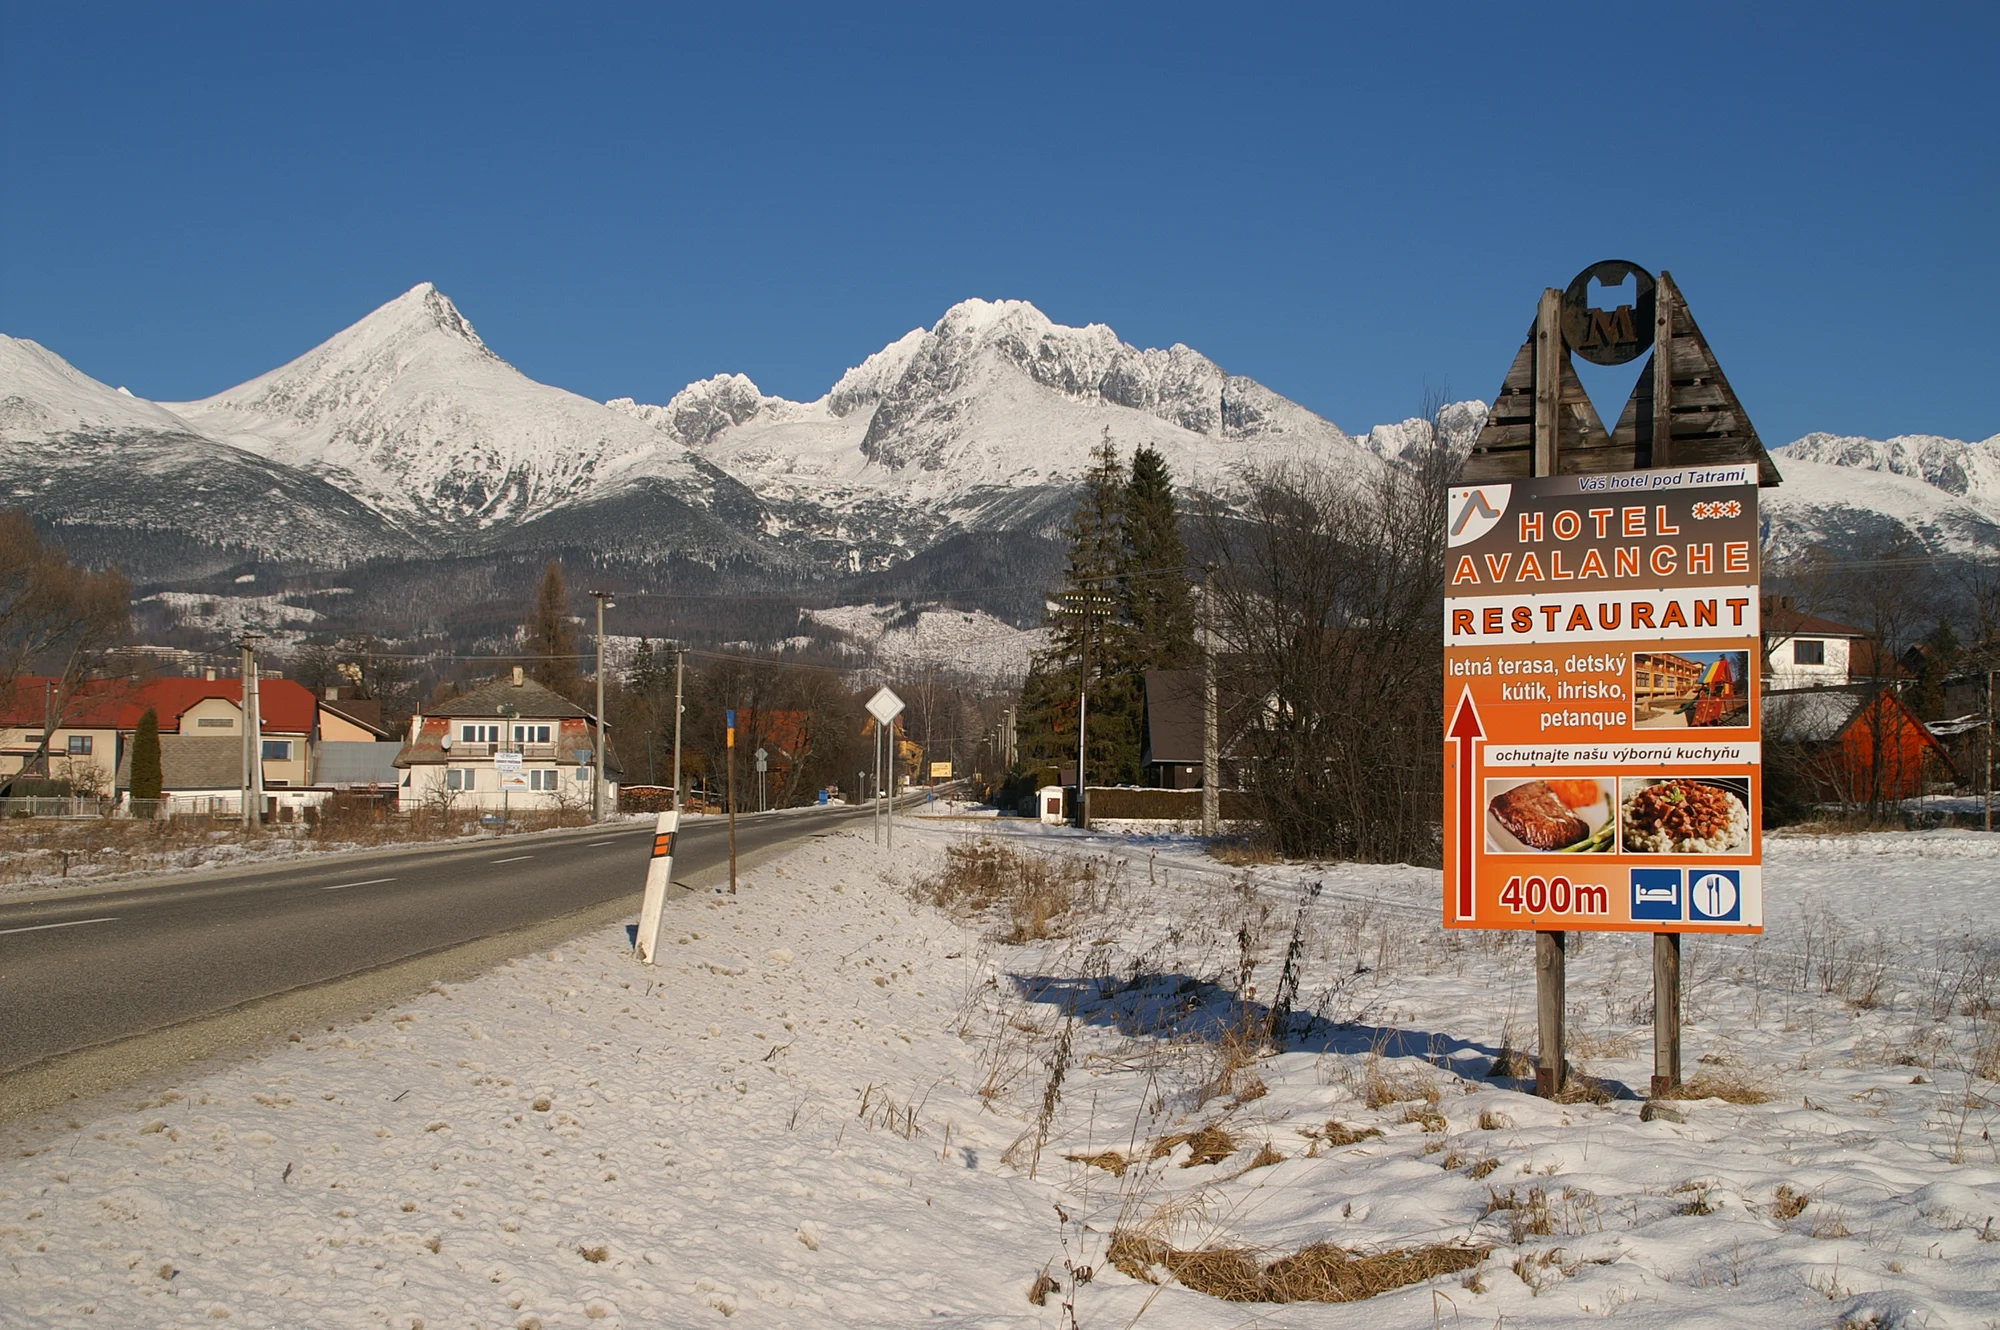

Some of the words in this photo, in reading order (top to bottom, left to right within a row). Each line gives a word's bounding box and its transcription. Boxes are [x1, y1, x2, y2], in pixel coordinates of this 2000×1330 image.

[1579, 475, 1607, 491] Váš
[1611, 474, 1649, 488] hotel
[1652, 473, 1682, 490] pod
[1688, 468, 1746, 484] Tatrami
[1519, 505, 1679, 543] HOTEL
[1451, 541, 1749, 585] AVALANCHE
[1452, 598, 1749, 636] RESTAURANT
[1449, 657, 1492, 676] letná
[1497, 657, 1559, 676] terasa,
[1564, 652, 1627, 676] detský
[1502, 681, 1551, 702] kútik,
[1557, 680, 1626, 701] ihrisko,
[1540, 708, 1627, 731] petanque
[1495, 749, 1569, 762] ochutnajte
[1574, 748, 1608, 761] našu
[1612, 747, 1672, 763] výbornú
[1676, 746, 1740, 763] kuchyňu
[1499, 875, 1609, 915] 400m
